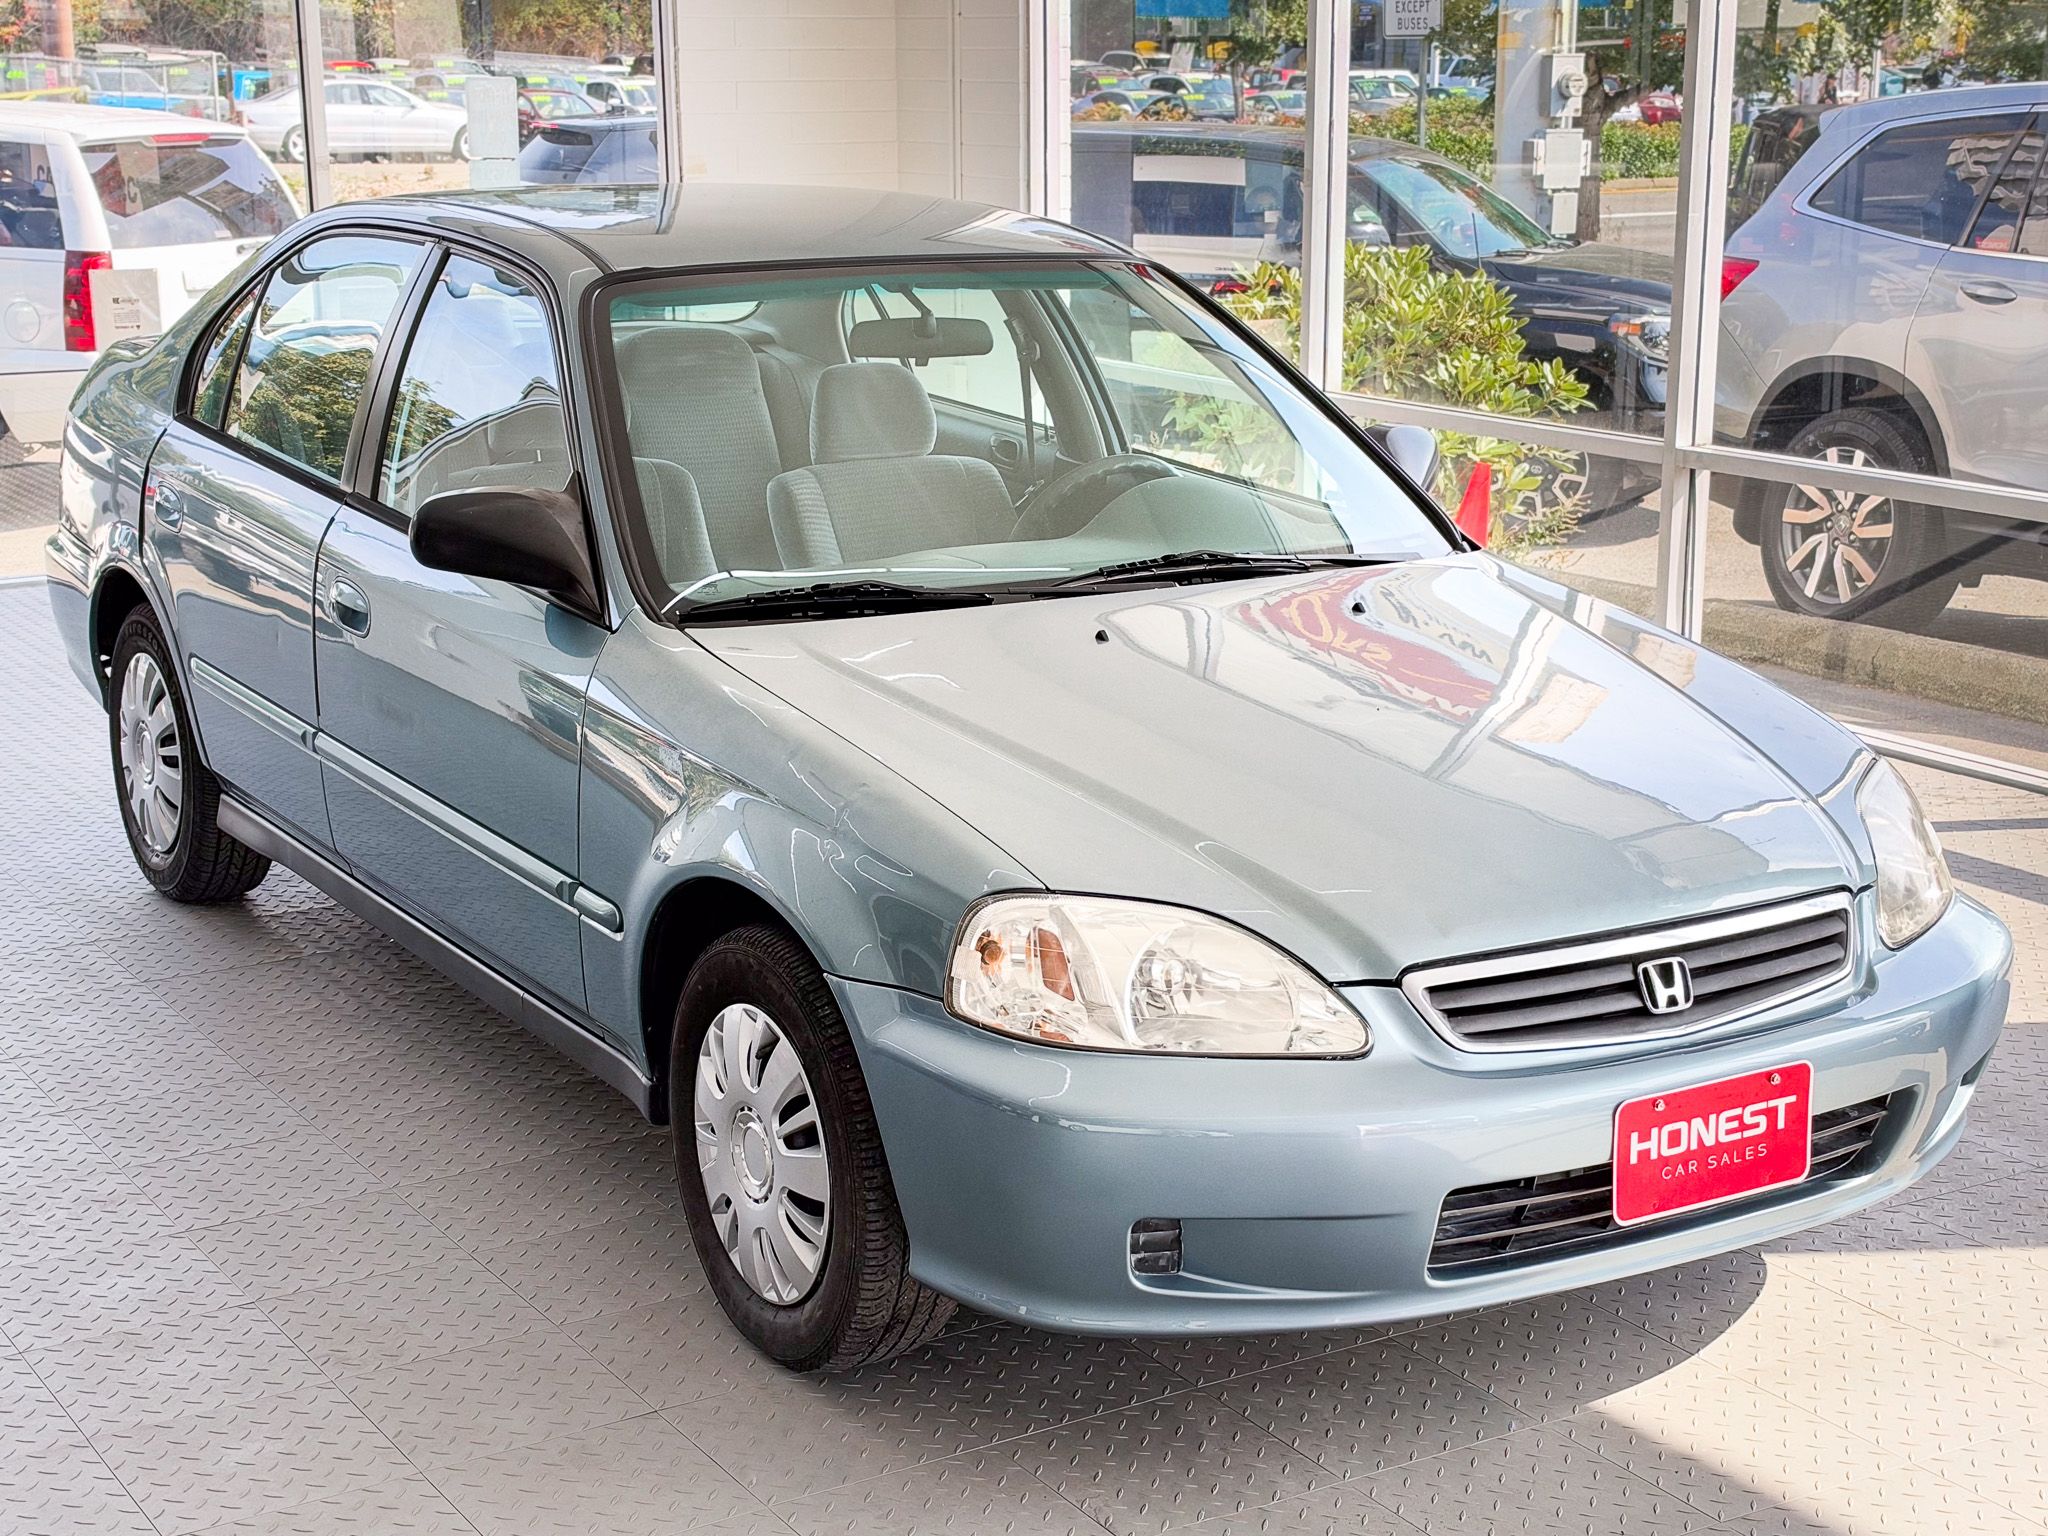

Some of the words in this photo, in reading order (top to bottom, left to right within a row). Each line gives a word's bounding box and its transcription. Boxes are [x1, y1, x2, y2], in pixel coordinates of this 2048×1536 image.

[1395, 0, 1430, 13] EXCEPT
[1397, 17, 1429, 30] BUSES
[1629, 1095, 1797, 1165] HONEST
[1661, 1160, 1697, 1180] CAR
[1708, 1143, 1768, 1169] SALES
